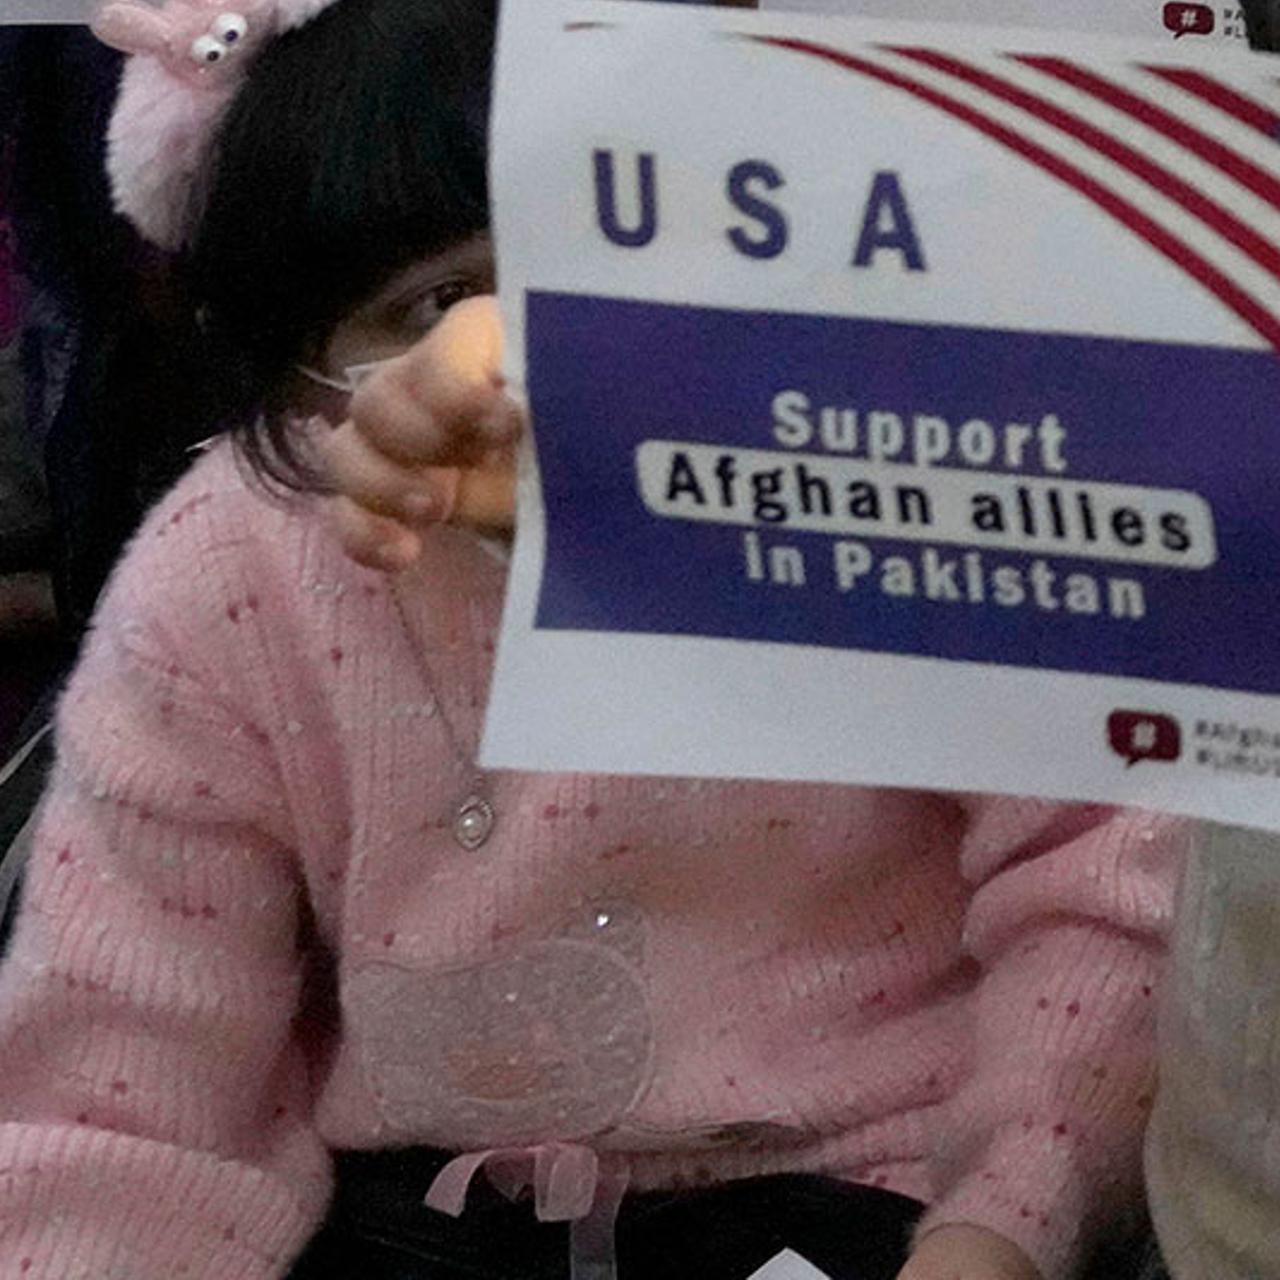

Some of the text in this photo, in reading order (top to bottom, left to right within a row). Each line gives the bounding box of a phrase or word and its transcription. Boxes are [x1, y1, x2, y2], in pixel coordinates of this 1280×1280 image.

[771, 391, 1068, 470] Support
[664, 451, 1190, 555] Afghan allies
[835, 541, 1146, 620] Pakistan
